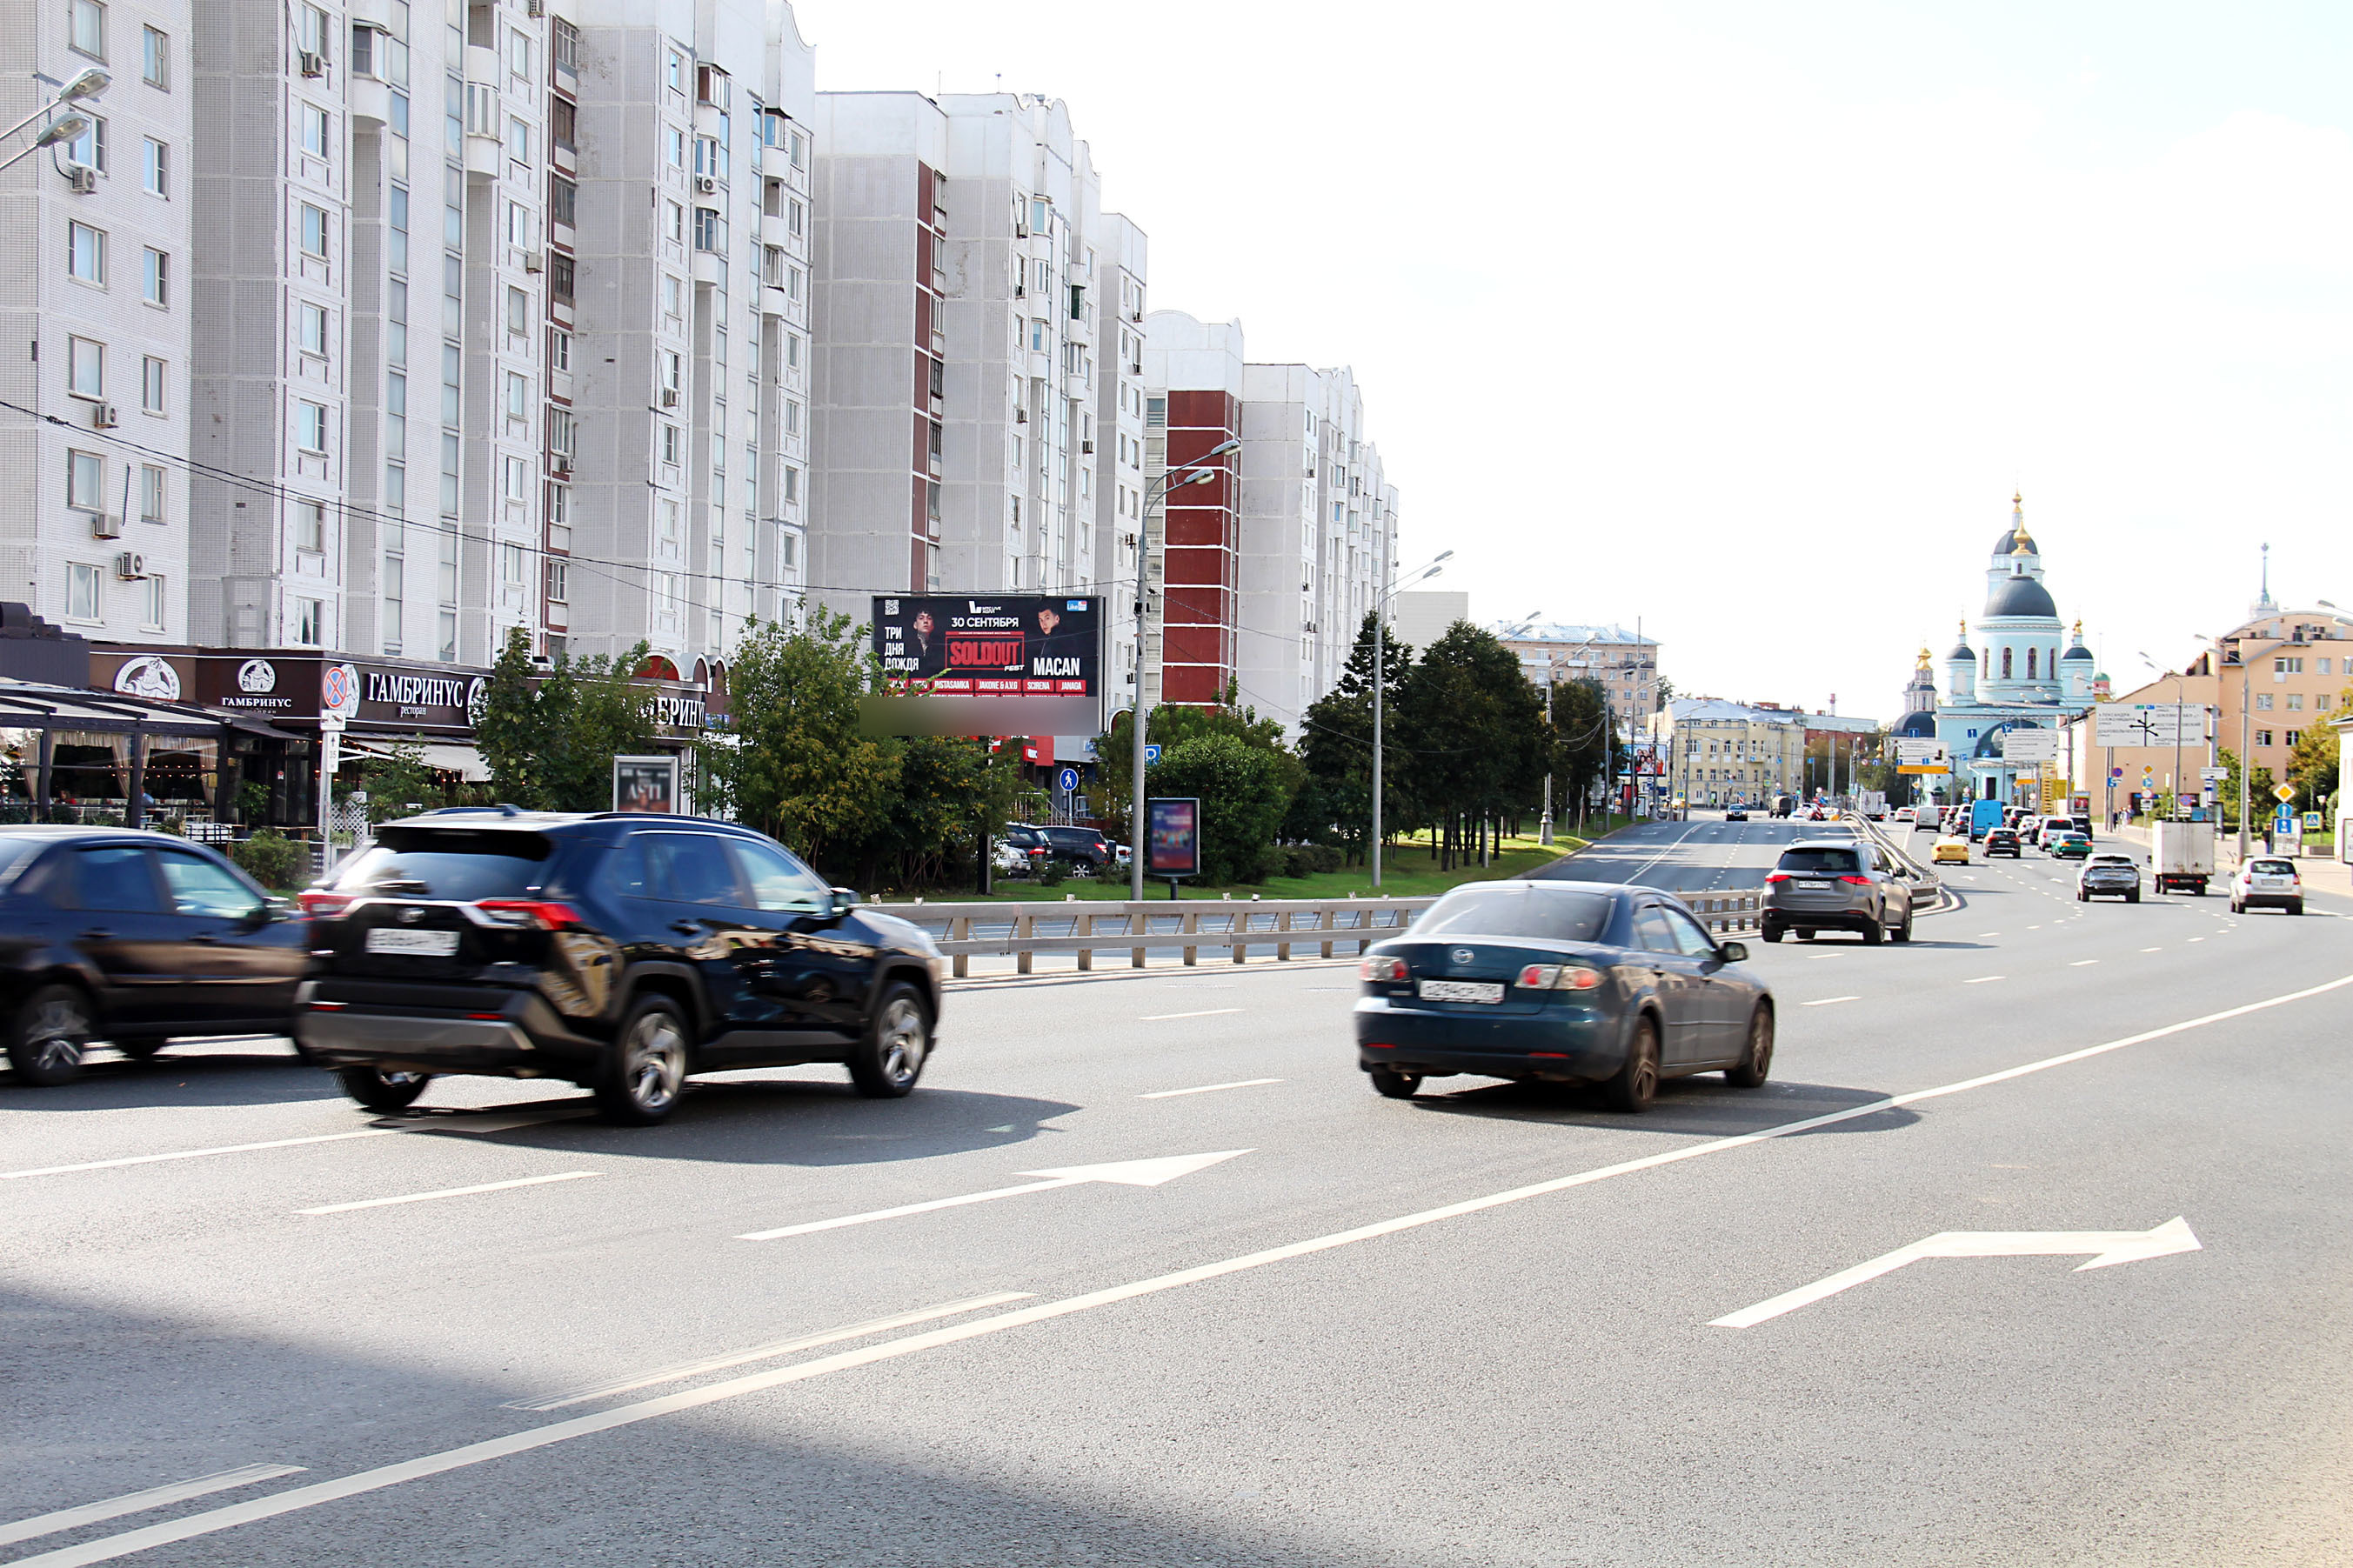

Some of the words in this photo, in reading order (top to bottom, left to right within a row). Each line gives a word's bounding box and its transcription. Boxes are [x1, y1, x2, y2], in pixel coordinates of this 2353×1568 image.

[951, 617, 965, 628] 30
[966, 617, 1019, 628] СЕНТЯБРЯ
[885, 626, 902, 640] ТРИ
[884, 642, 905, 657] ДНЯ
[950, 641, 1019, 666] SOLDOUT
[884, 657, 919, 672] ДОЖДЯ
[1033, 657, 1080, 677] MACAN
[369, 672, 464, 709] ГАМБРИНУС
[221, 697, 292, 708] ГАМБРИНУС
[400, 705, 427, 718] ресторан
